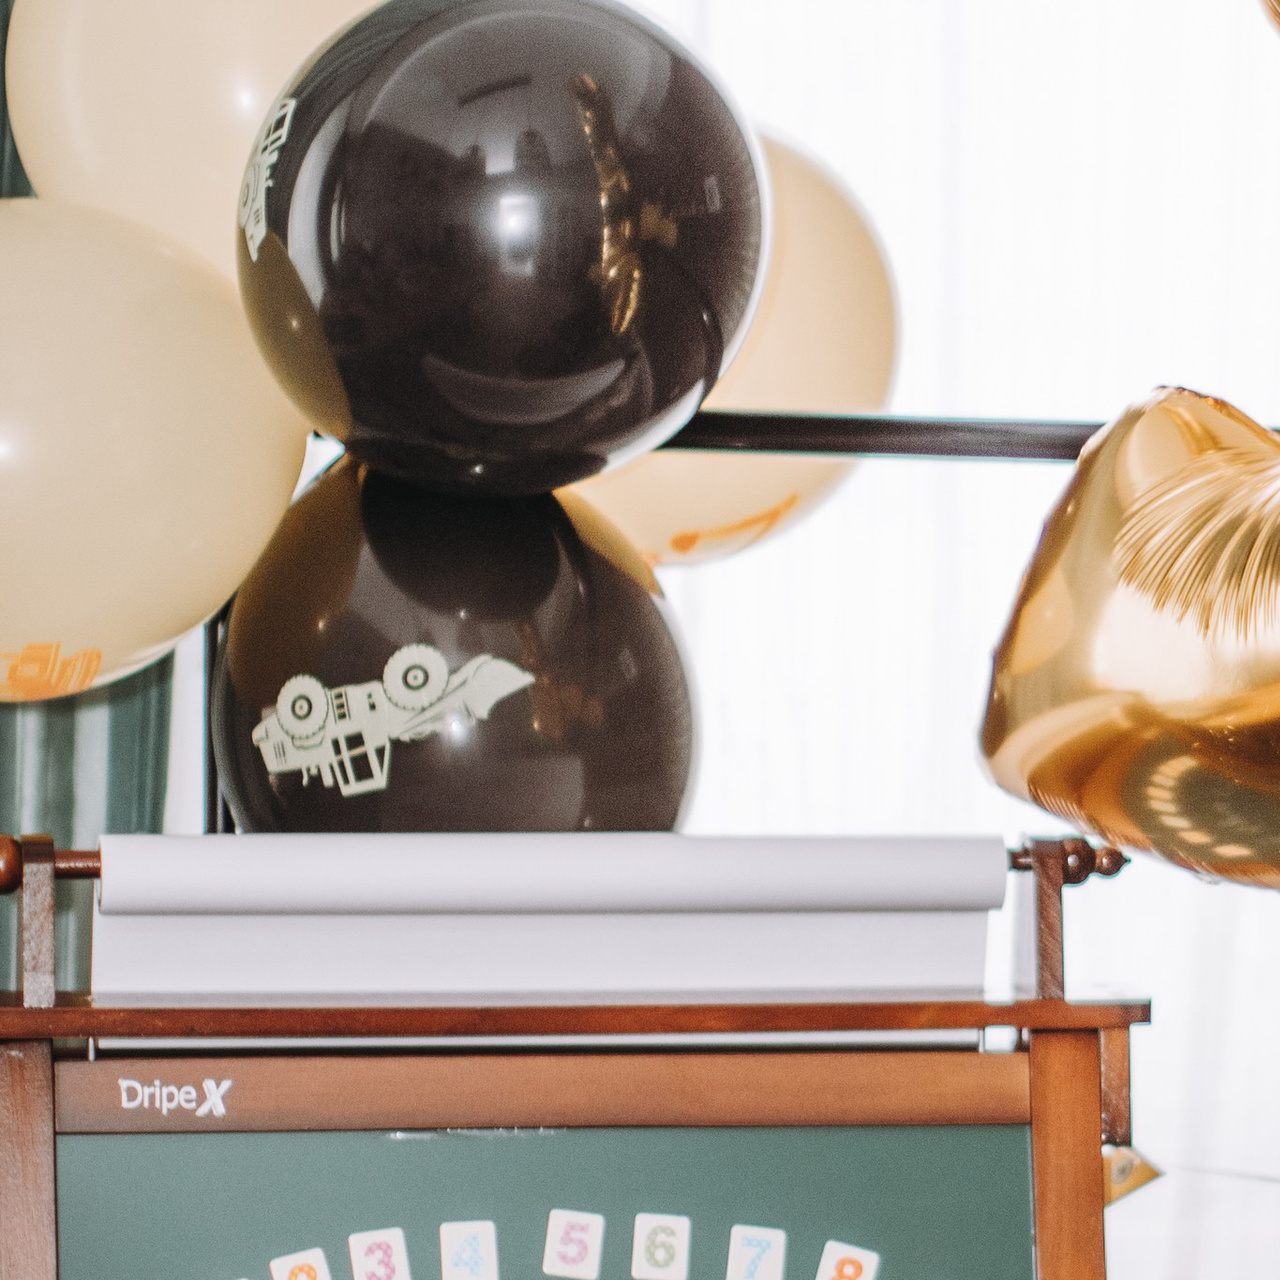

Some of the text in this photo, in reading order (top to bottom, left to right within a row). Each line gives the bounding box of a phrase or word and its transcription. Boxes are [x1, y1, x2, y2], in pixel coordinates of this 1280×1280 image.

[452, 1232, 485, 1276] 4
[556, 1221, 590, 1266] 5
[644, 1225, 678, 1269] 6
[741, 1236, 772, 1280] 7
